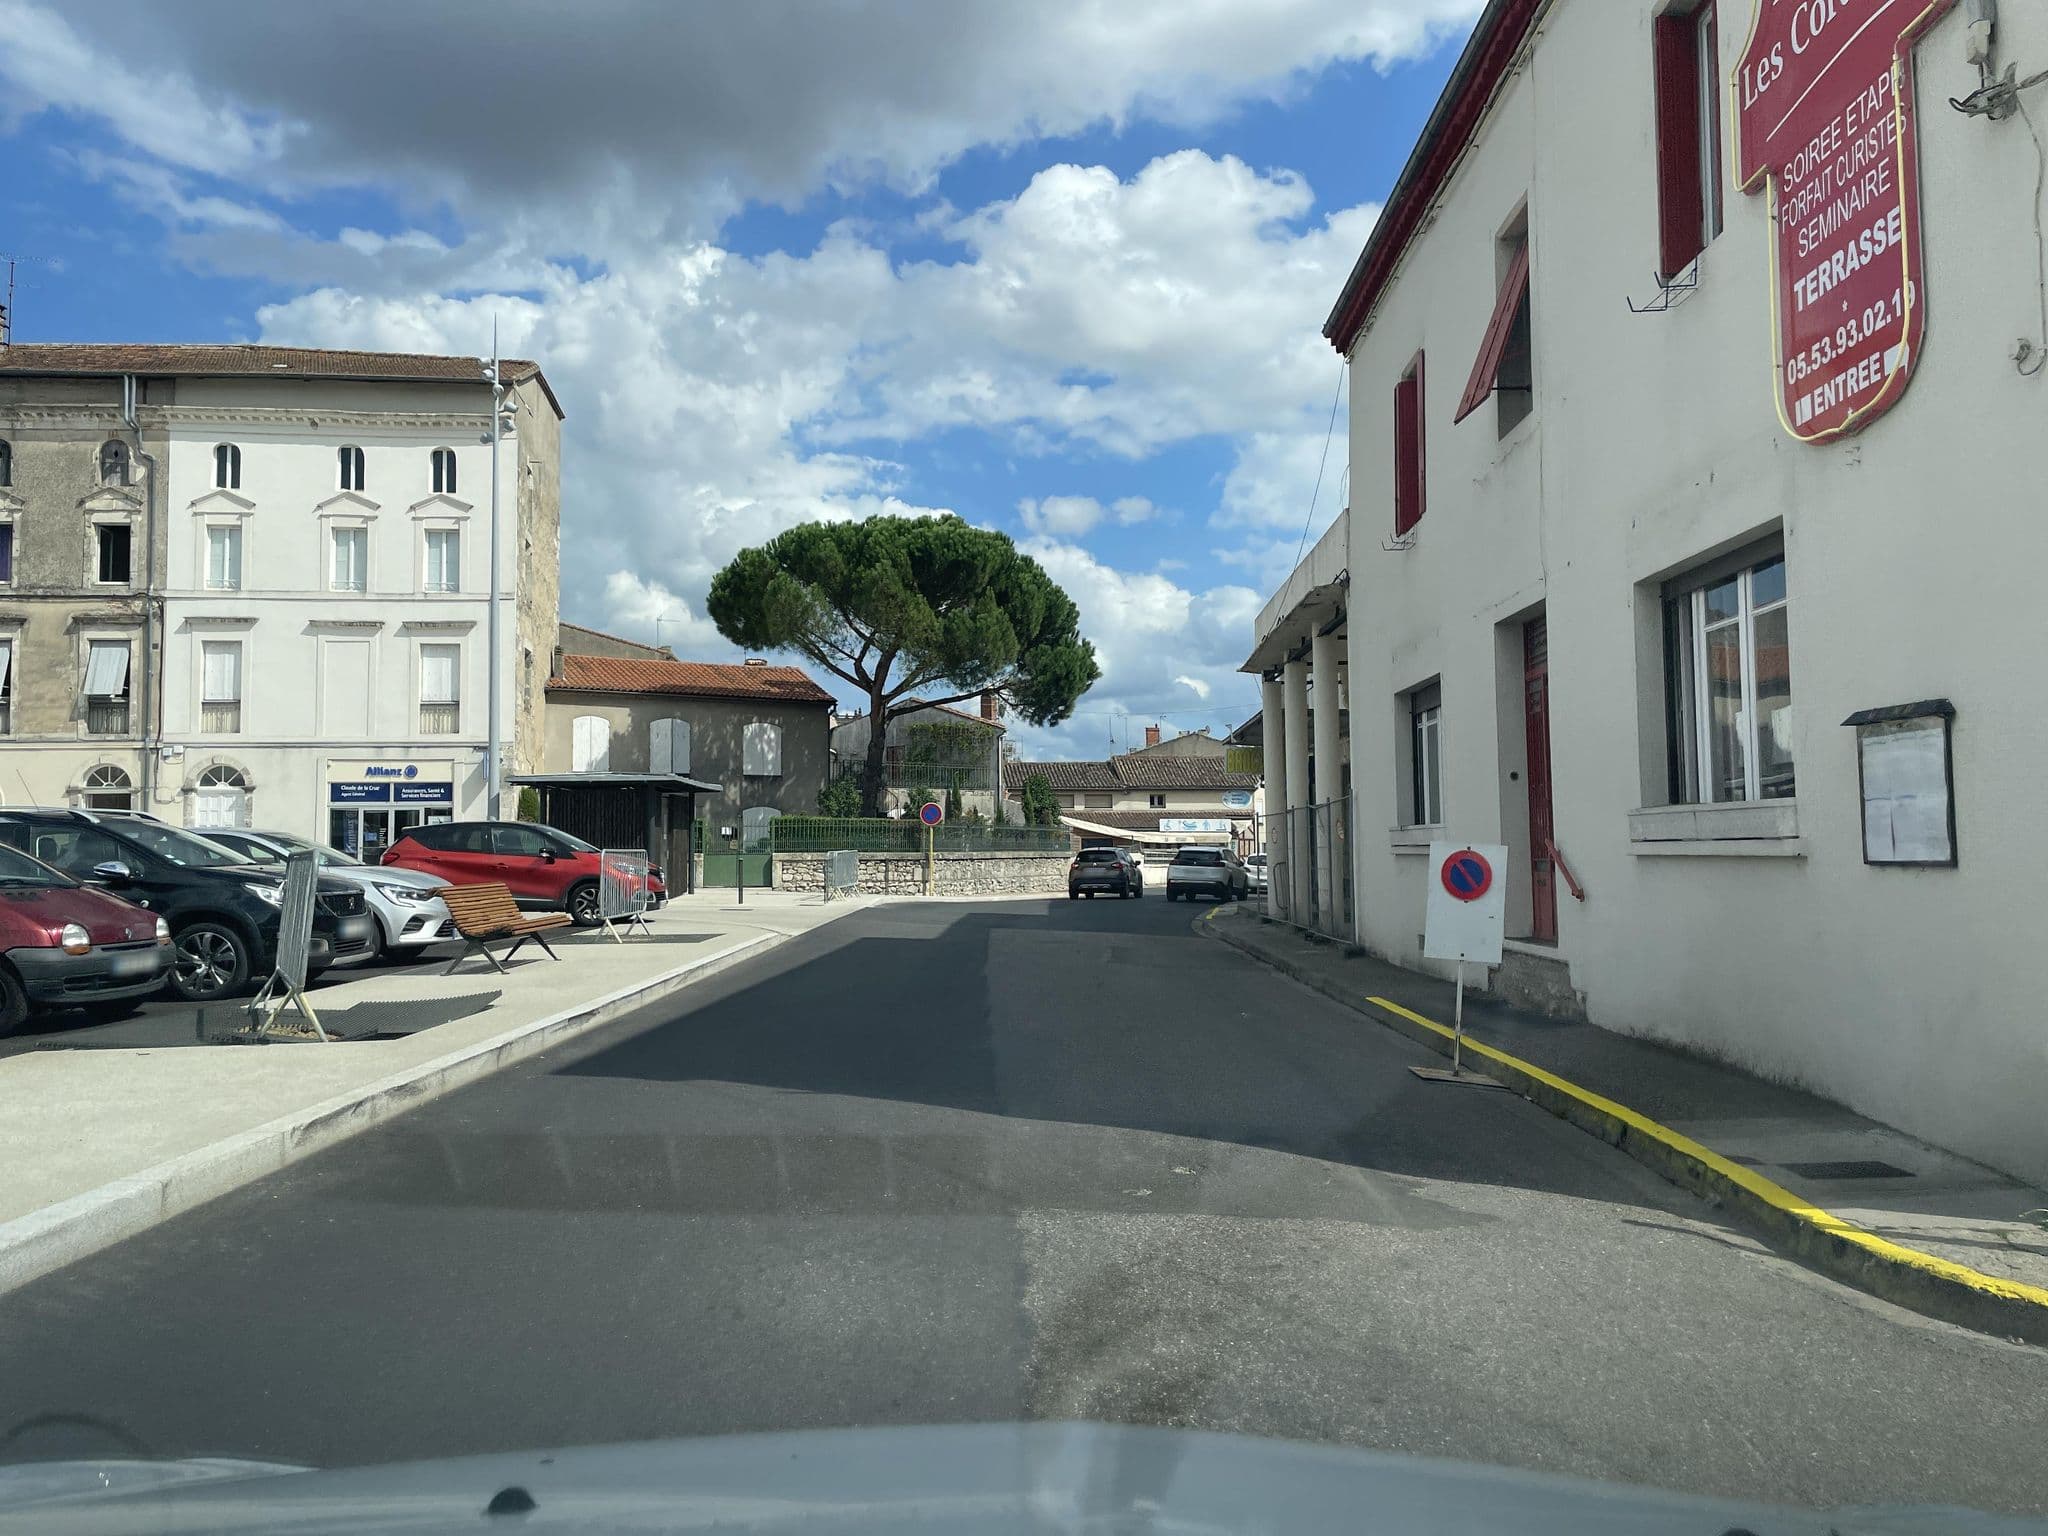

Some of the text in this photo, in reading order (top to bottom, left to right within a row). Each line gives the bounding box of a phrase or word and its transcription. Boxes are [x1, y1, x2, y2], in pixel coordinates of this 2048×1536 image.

[1742, 41, 1784, 111] Les
[1784, 116, 1842, 193] SOIREE
[1782, 165, 1833, 235] FORFAIT
[1798, 157, 1892, 258] SEMINAIRE
[1793, 205, 1902, 312] TERRASSE
[1814, 351, 1882, 416] ENTREE
[365, 766, 402, 777] Allianz
